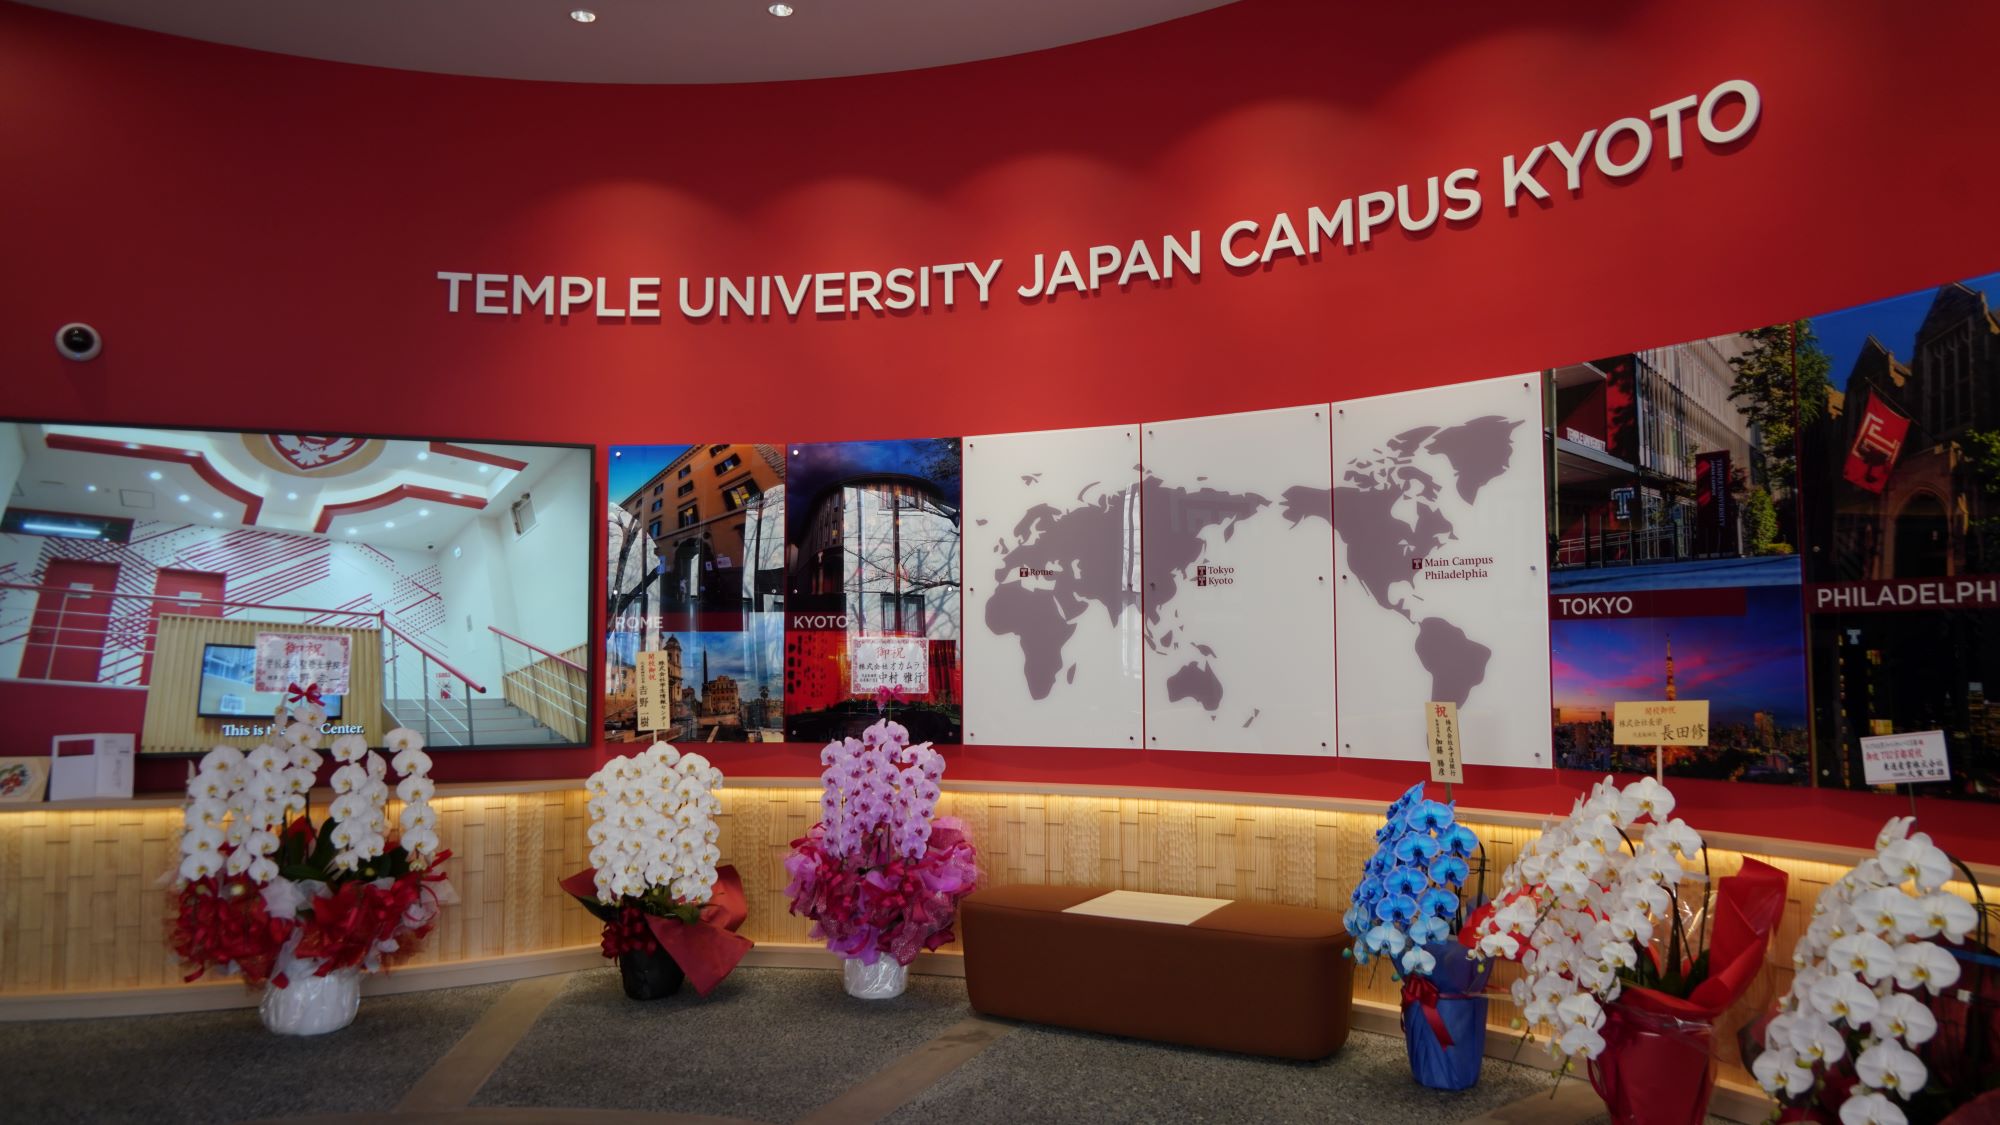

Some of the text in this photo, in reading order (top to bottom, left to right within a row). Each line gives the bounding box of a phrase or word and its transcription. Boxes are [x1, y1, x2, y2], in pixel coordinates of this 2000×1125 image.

[437, 79, 1762, 318] TEMPLE UNIVERSITY JAPAN CAMPUS KYOTO
[1424, 558, 1449, 567] Main
[1452, 556, 1493, 567] Campus
[1030, 568, 1053, 576] Rome
[1208, 566, 1234, 576] Tokyo
[1424, 569, 1488, 580] Philadelphia
[1208, 577, 1234, 586] Kyoto
[1558, 596, 1633, 616] TOKYO
[615, 616, 664, 629] ROME
[793, 615, 849, 629] KYOTO
[876, 646, 906, 660] 御祝
[858, 661, 920, 671] 株式会社オカムラ
[1434, 704, 1448, 718] 祝
[222, 724, 250, 736] This
[253, 724, 264, 736] is
[320, 723, 364, 735] Center.
